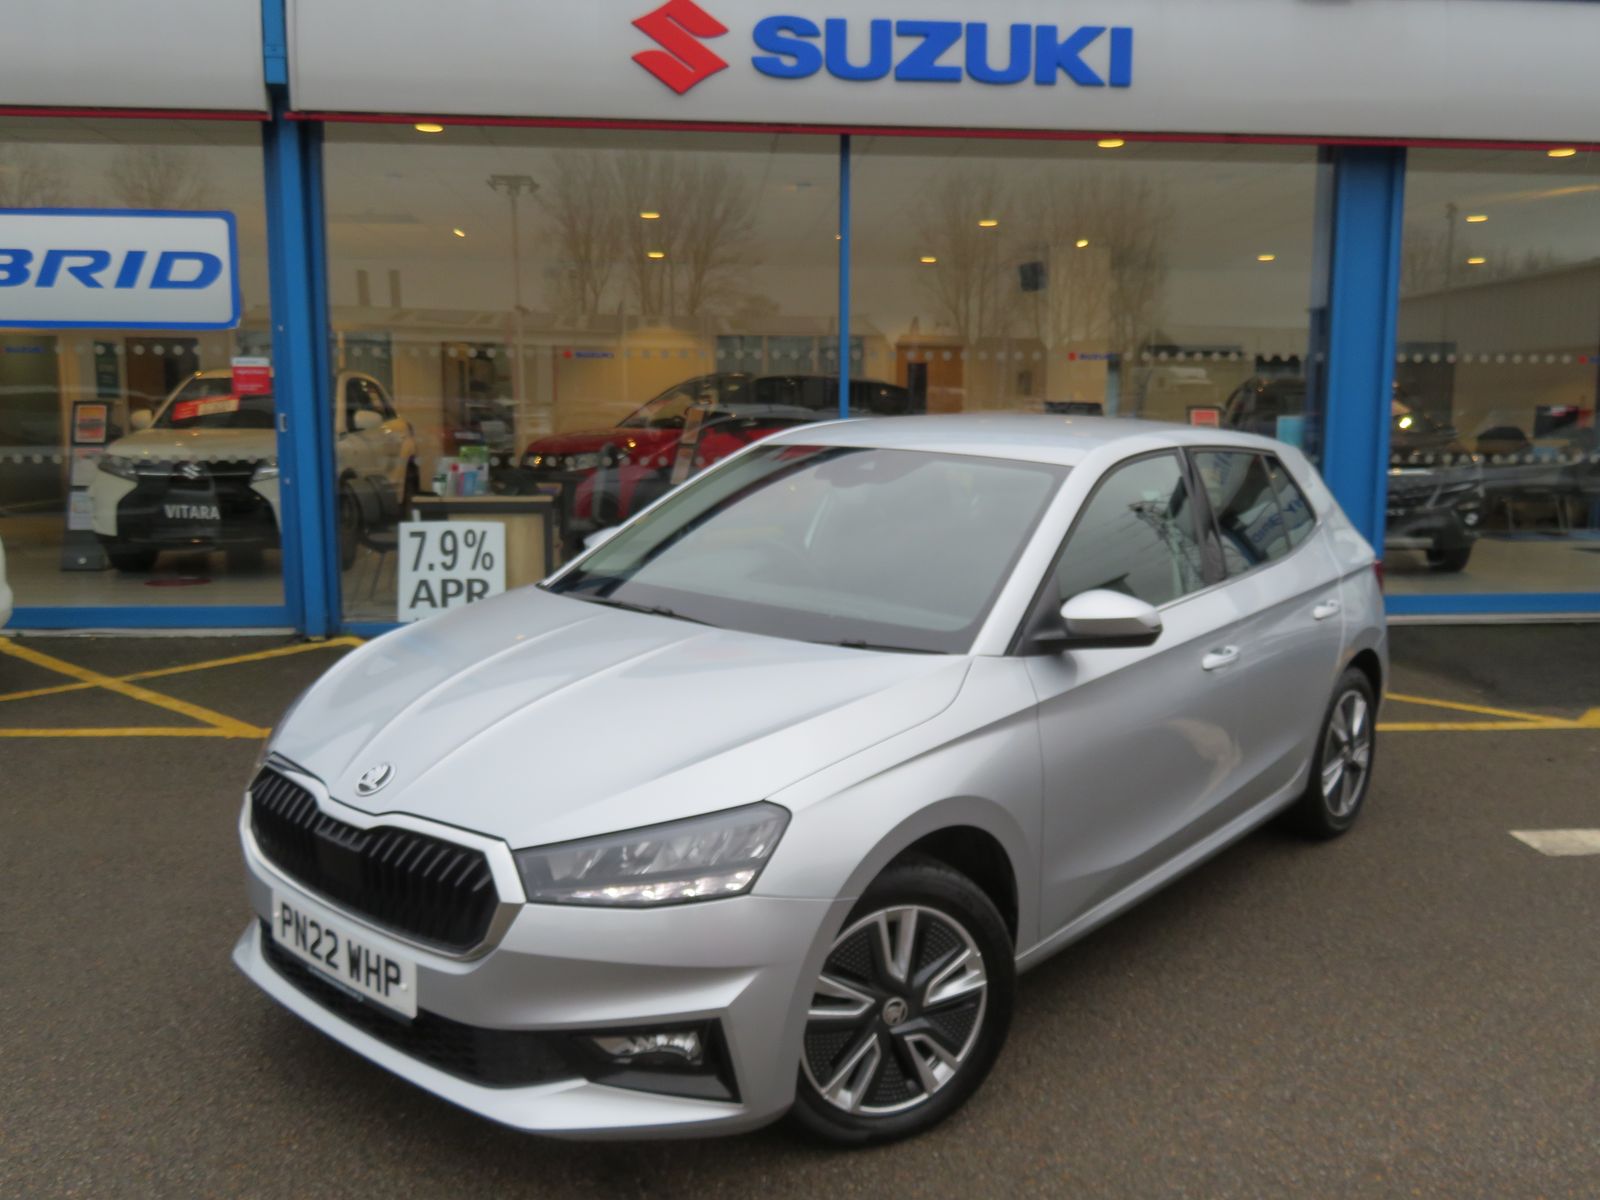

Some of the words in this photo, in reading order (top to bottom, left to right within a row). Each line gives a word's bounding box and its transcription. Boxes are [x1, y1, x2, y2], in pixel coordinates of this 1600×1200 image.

[752, 15, 1133, 88] SUZUKI
[164, 504, 221, 520] VITARA
[409, 529, 495, 572] 7.9%
[409, 578, 490, 609] APR
[281, 901, 339, 970] PN22
[347, 939, 401, 998] WHP
